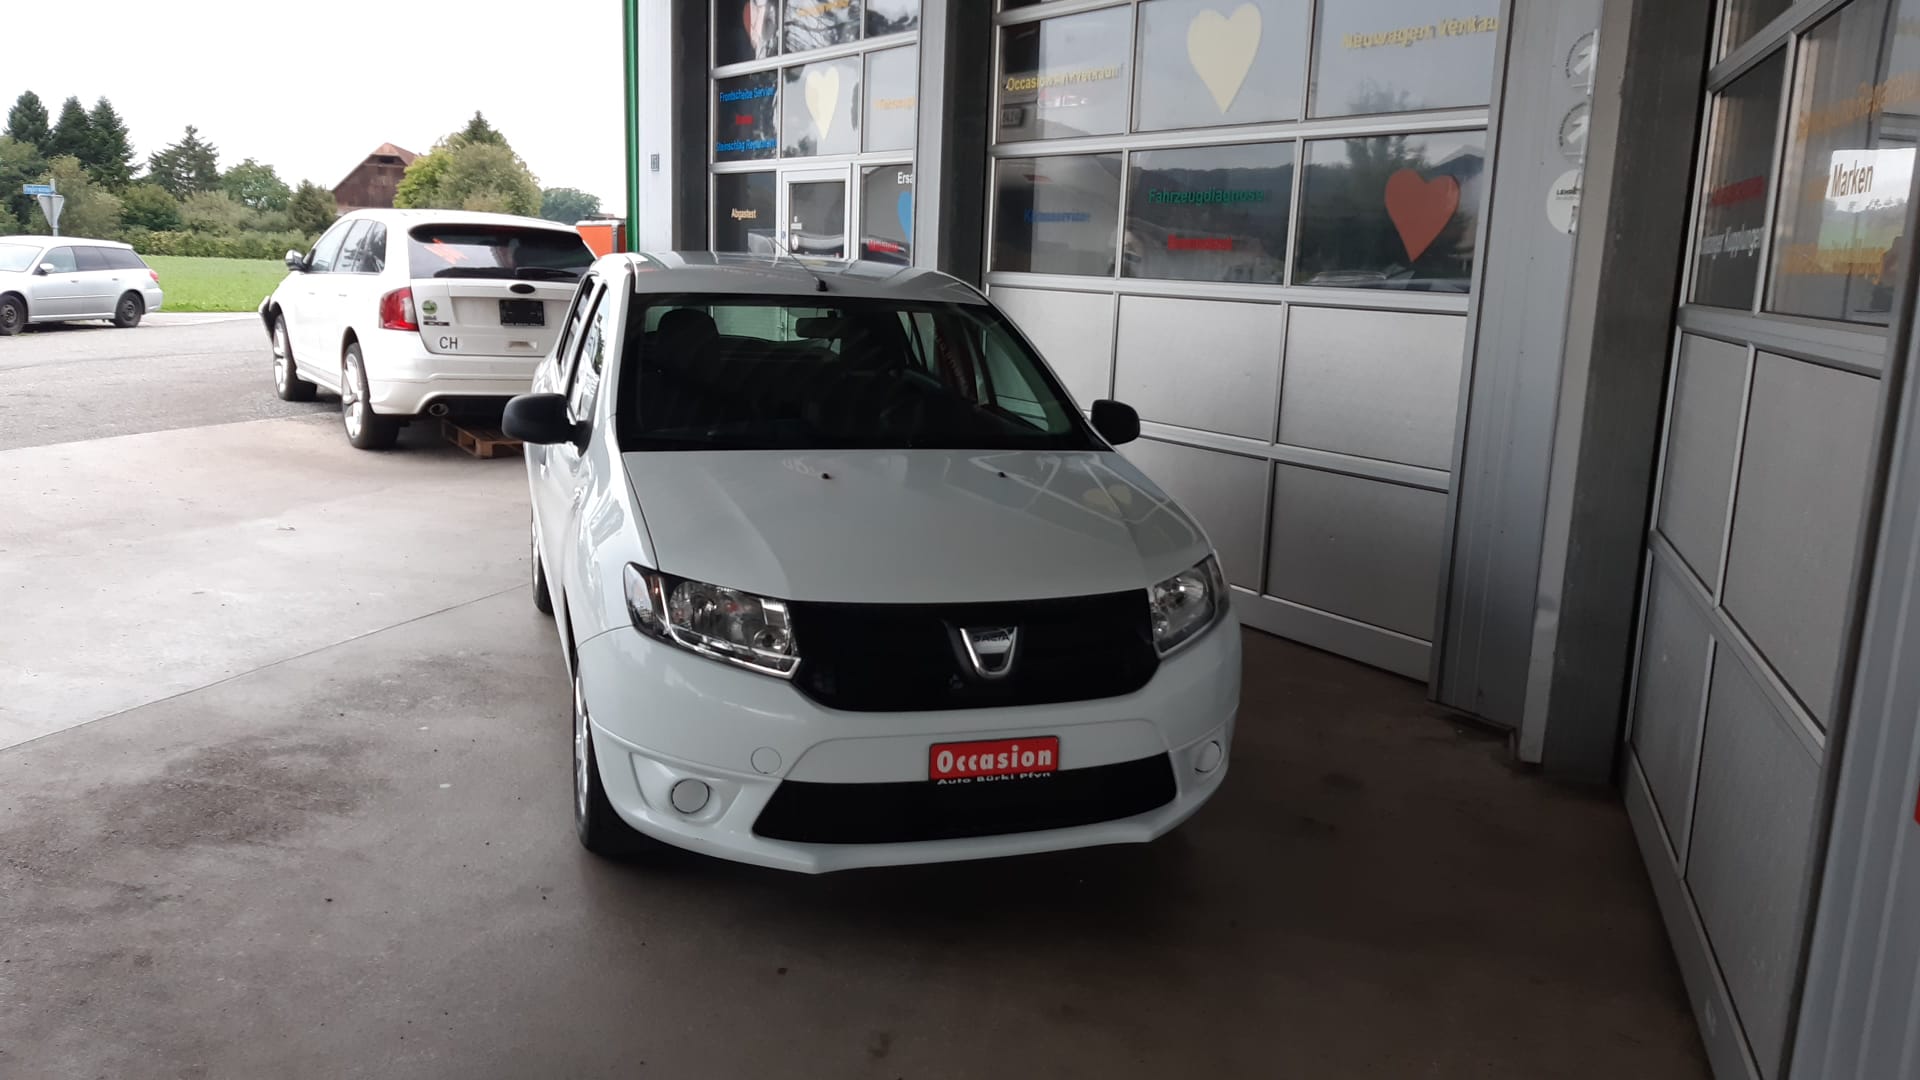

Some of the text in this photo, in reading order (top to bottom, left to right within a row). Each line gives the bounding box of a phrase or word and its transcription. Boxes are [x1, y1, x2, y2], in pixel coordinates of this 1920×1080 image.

[1831, 160, 1873, 197] Marken
[439, 336, 458, 349] CH
[937, 745, 1051, 773] Occasion
